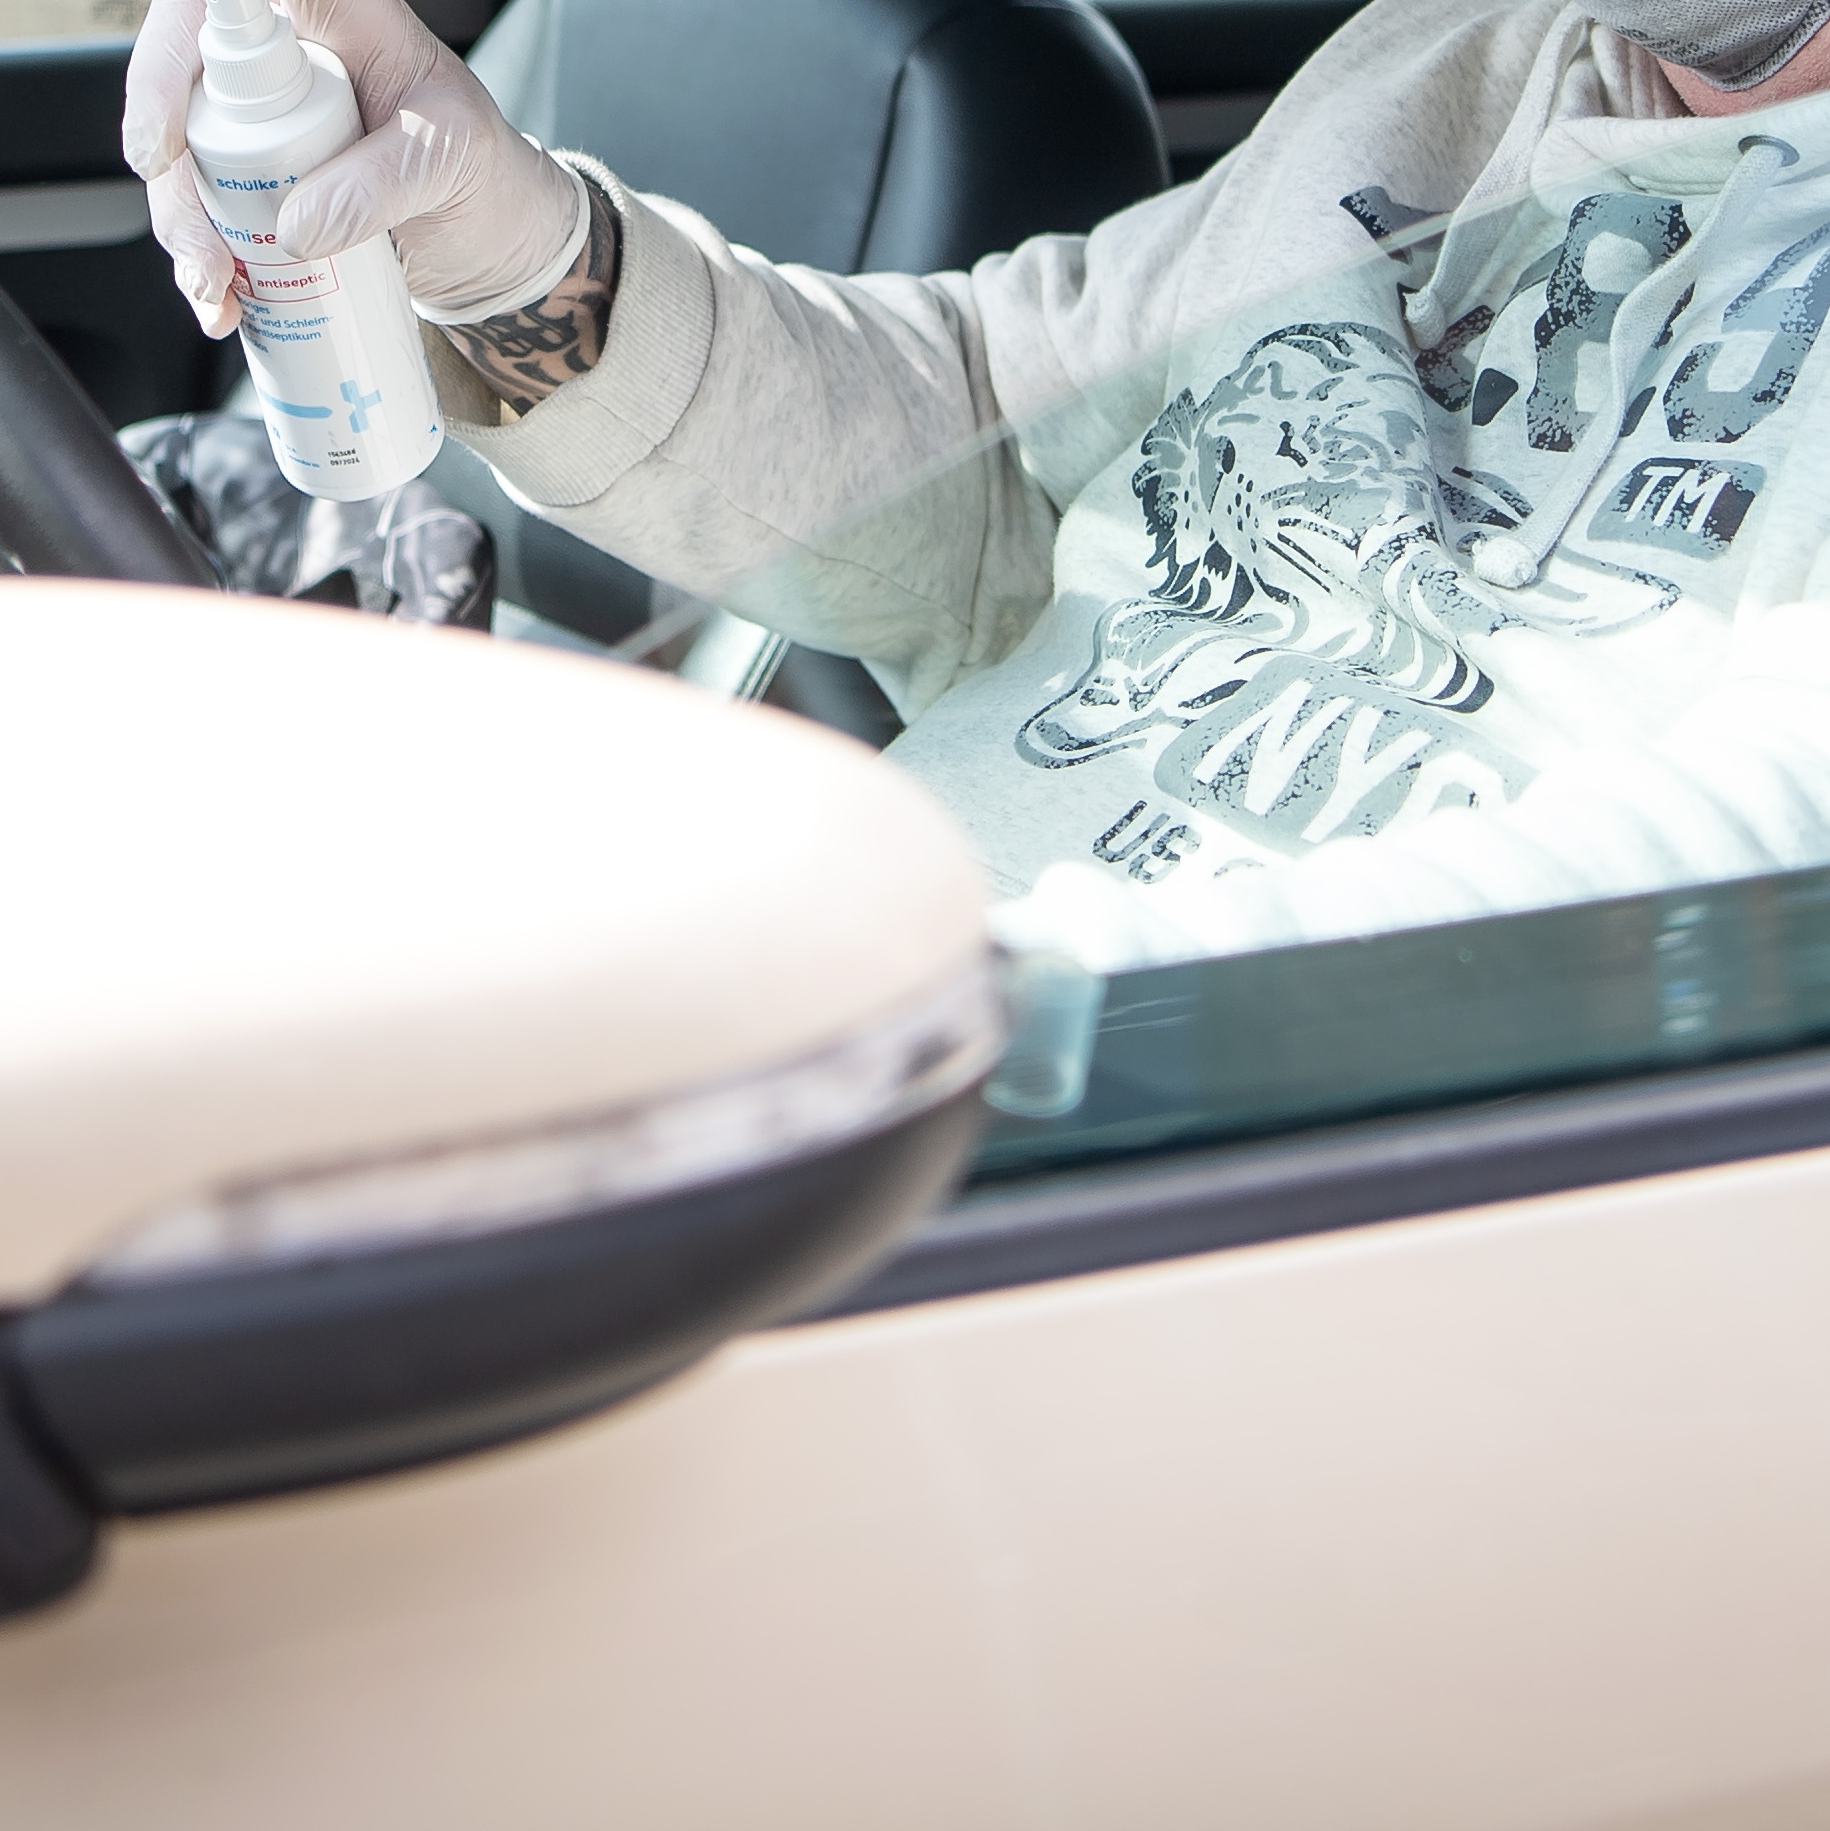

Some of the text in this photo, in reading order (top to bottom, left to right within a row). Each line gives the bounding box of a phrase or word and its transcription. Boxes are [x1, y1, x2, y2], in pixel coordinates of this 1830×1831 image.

[216, 176, 279, 191] schülke
[210, 218, 276, 245] tenise
[256, 272, 327, 289] antiseptic
[260, 317, 282, 329] und
[283, 314, 336, 329] Schleim-
[1625, 465, 1732, 534] TM
[1092, 800, 1203, 885] US
